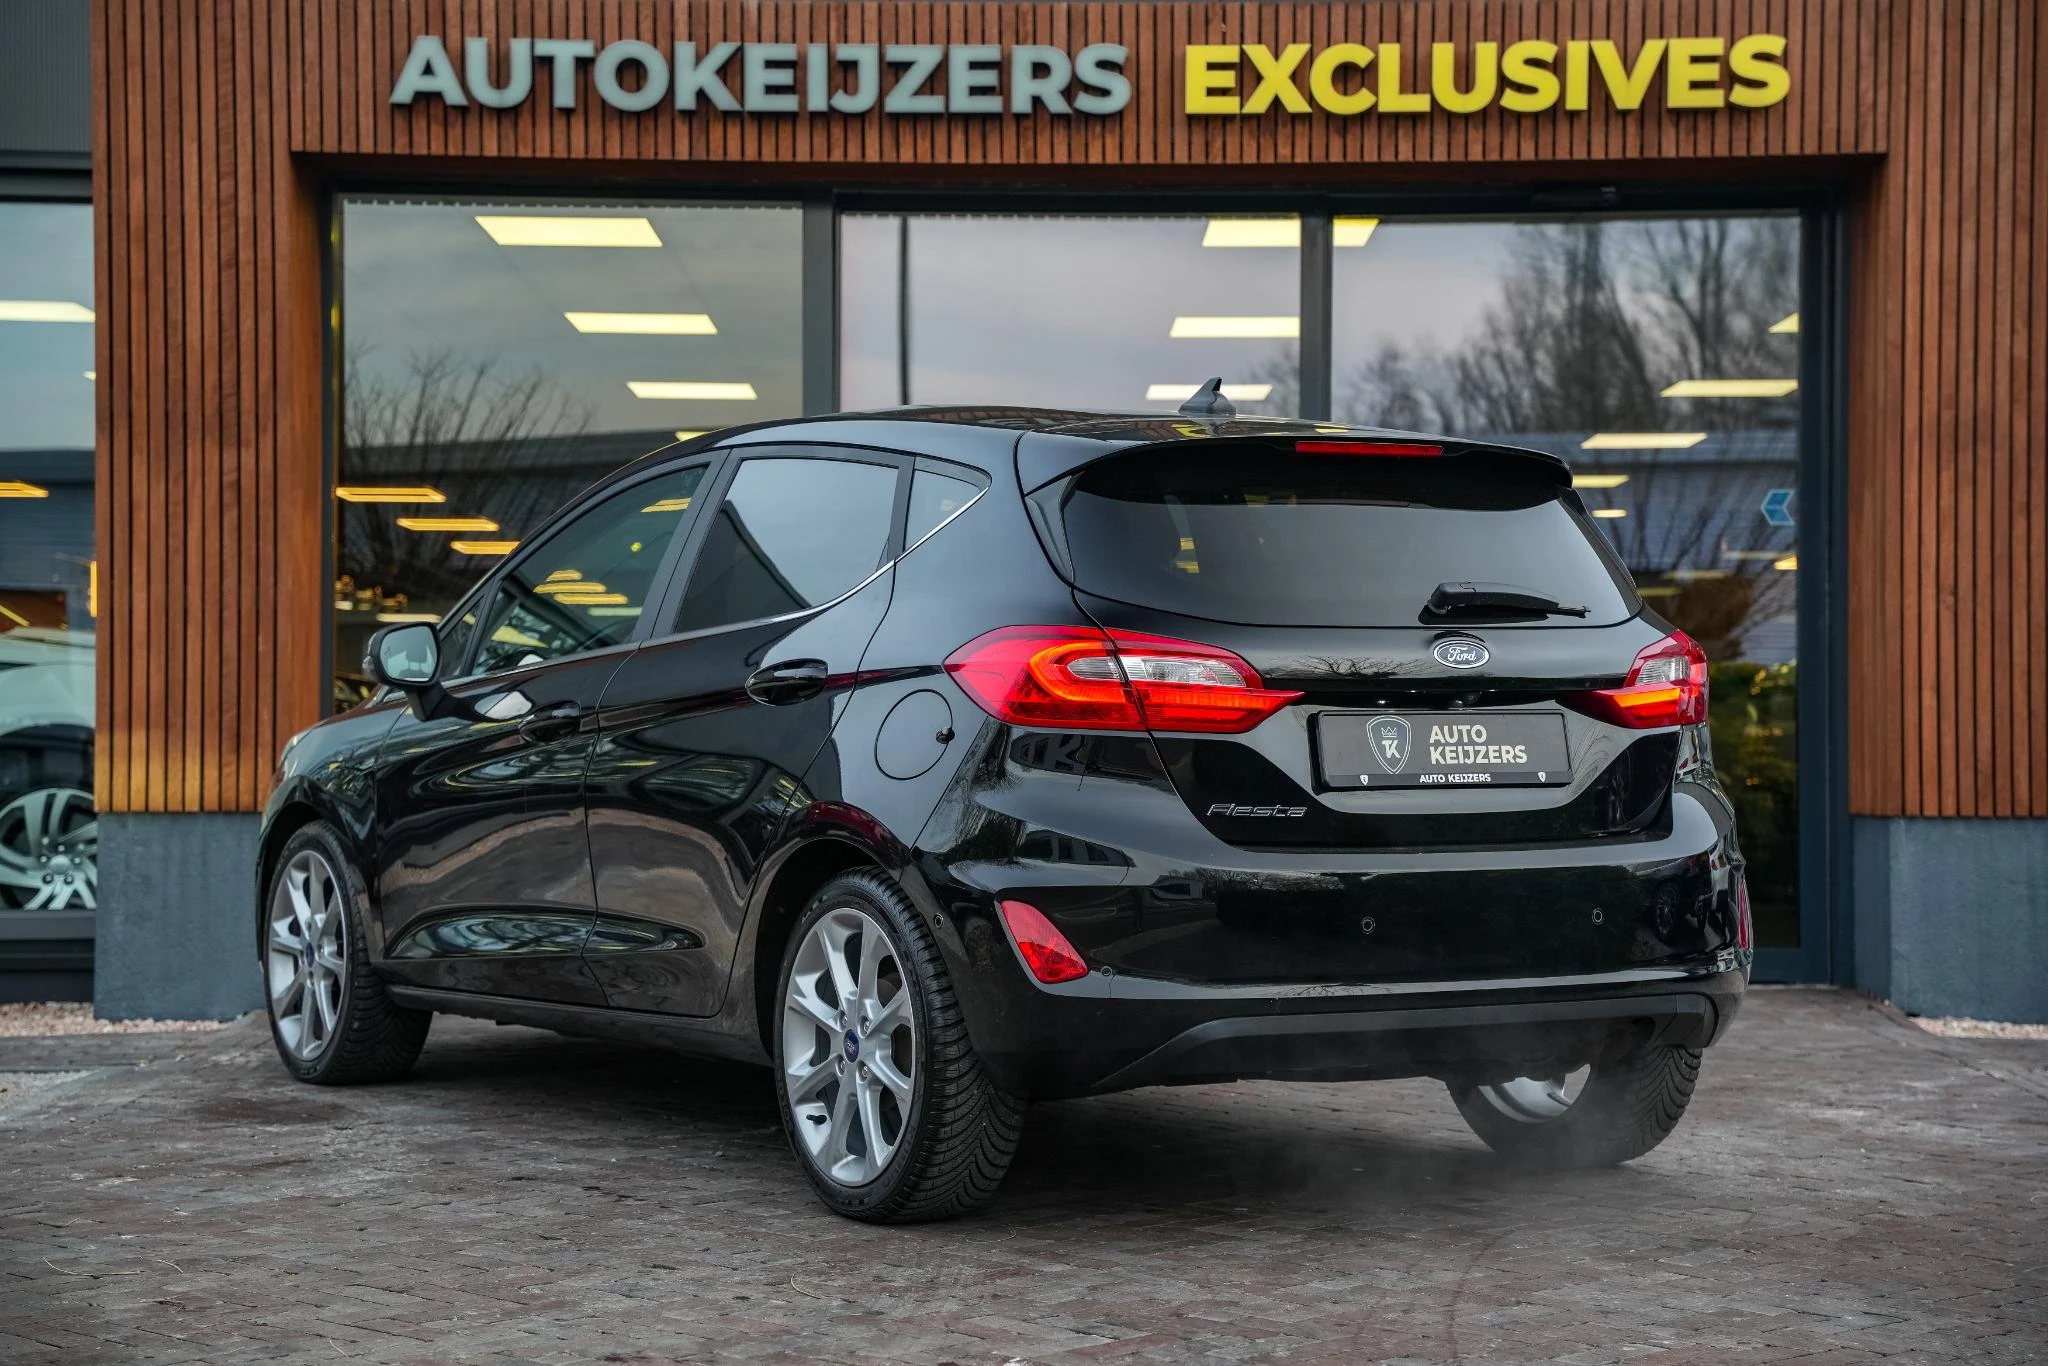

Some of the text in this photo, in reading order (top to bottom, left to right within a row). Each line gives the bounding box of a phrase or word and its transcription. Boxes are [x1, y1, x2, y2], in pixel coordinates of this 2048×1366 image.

[389, 34, 1791, 116] AUTOKEIJZERS EXCLUSIVES
[1447, 646, 1477, 661] Ford
[1429, 724, 1487, 744] AUTO
[1429, 745, 1528, 765] KEIJZERS
[1419, 773, 1492, 783] AUTO KEIJZERS
[1206, 803, 1308, 817] Fiesta
